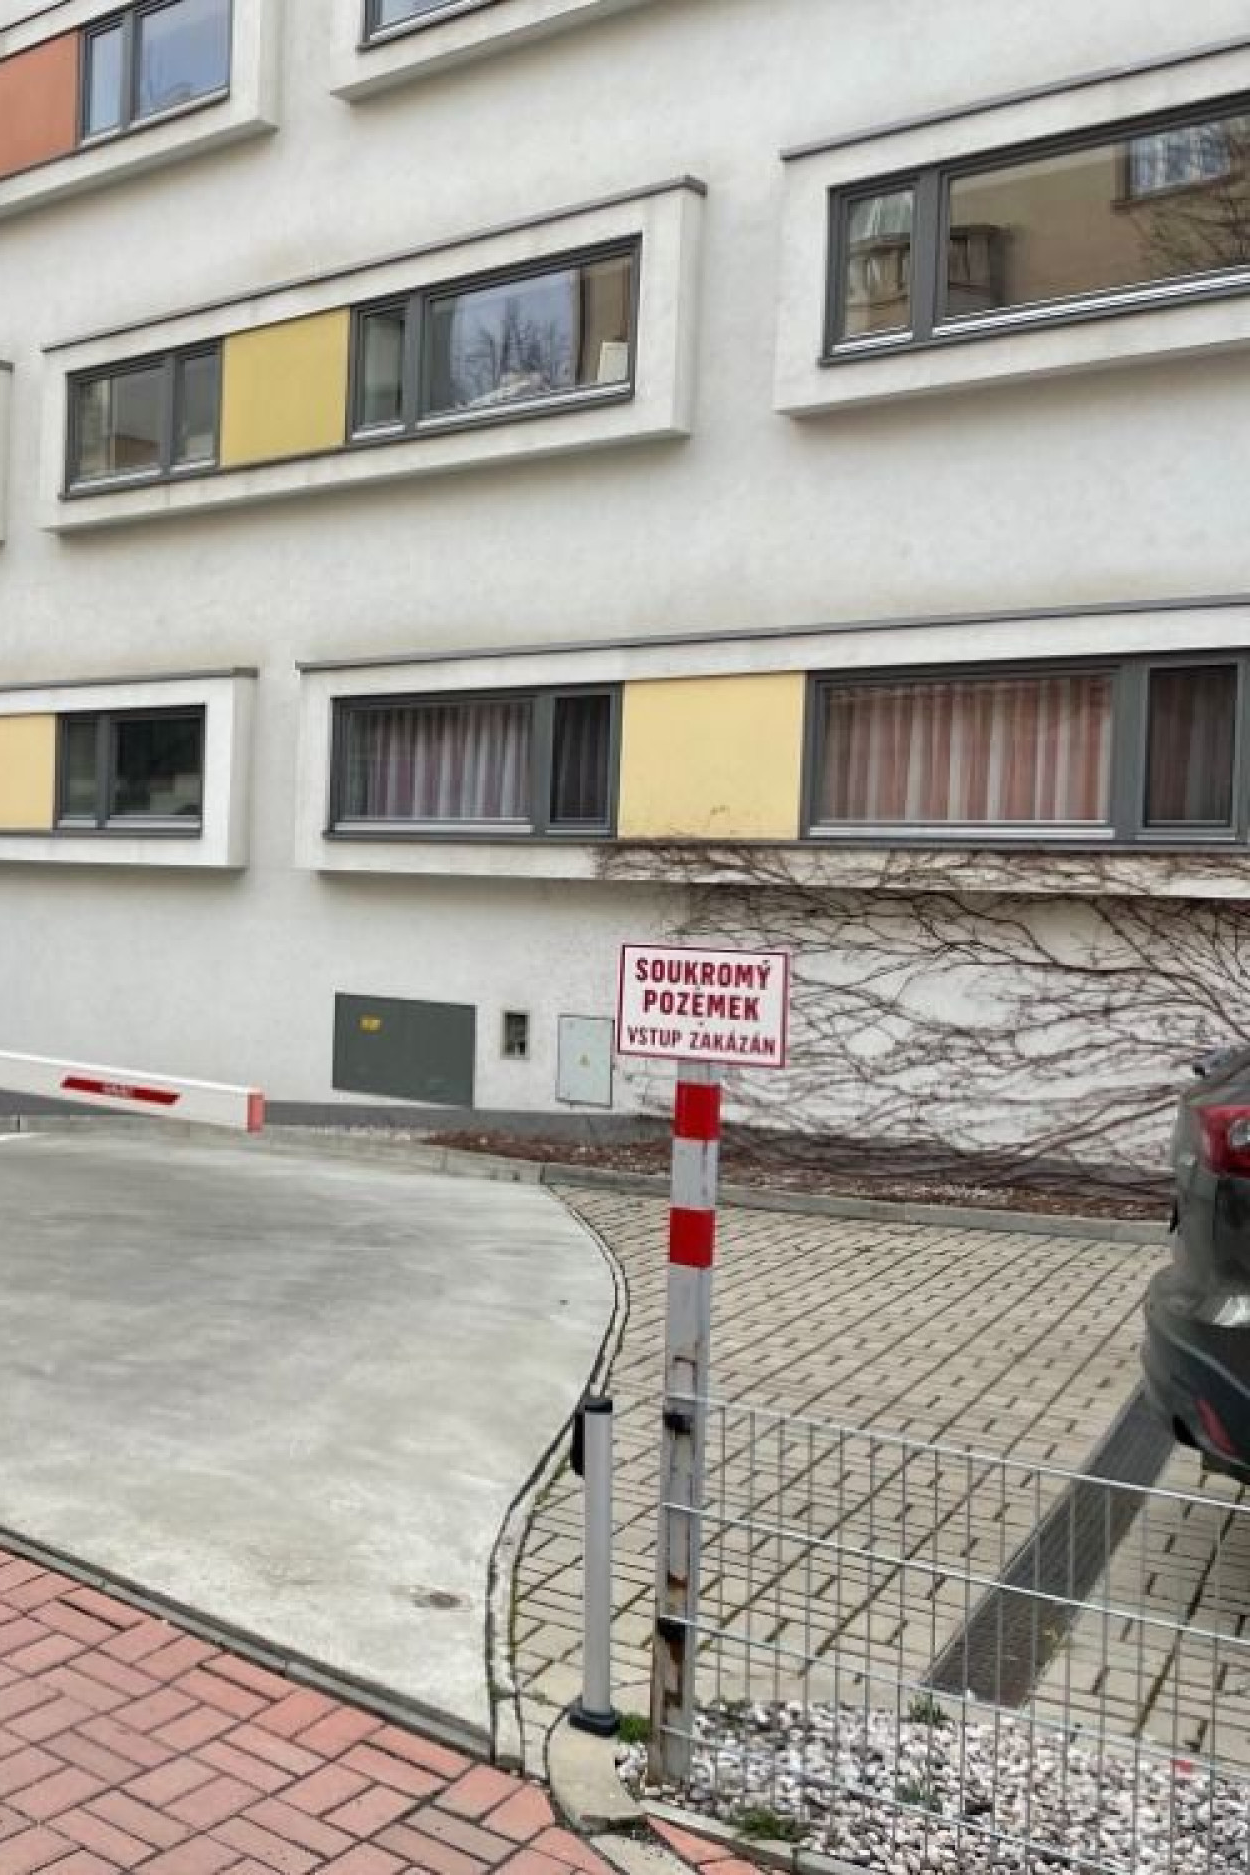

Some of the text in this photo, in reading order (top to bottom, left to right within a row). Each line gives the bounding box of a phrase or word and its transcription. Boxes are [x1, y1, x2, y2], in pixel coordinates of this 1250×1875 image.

[635, 957, 771, 990] SOUKROMÝ
[643, 989, 761, 1021] POZEMEK
[627, 1024, 776, 1055] VSTUP ZAKÁZÁN
